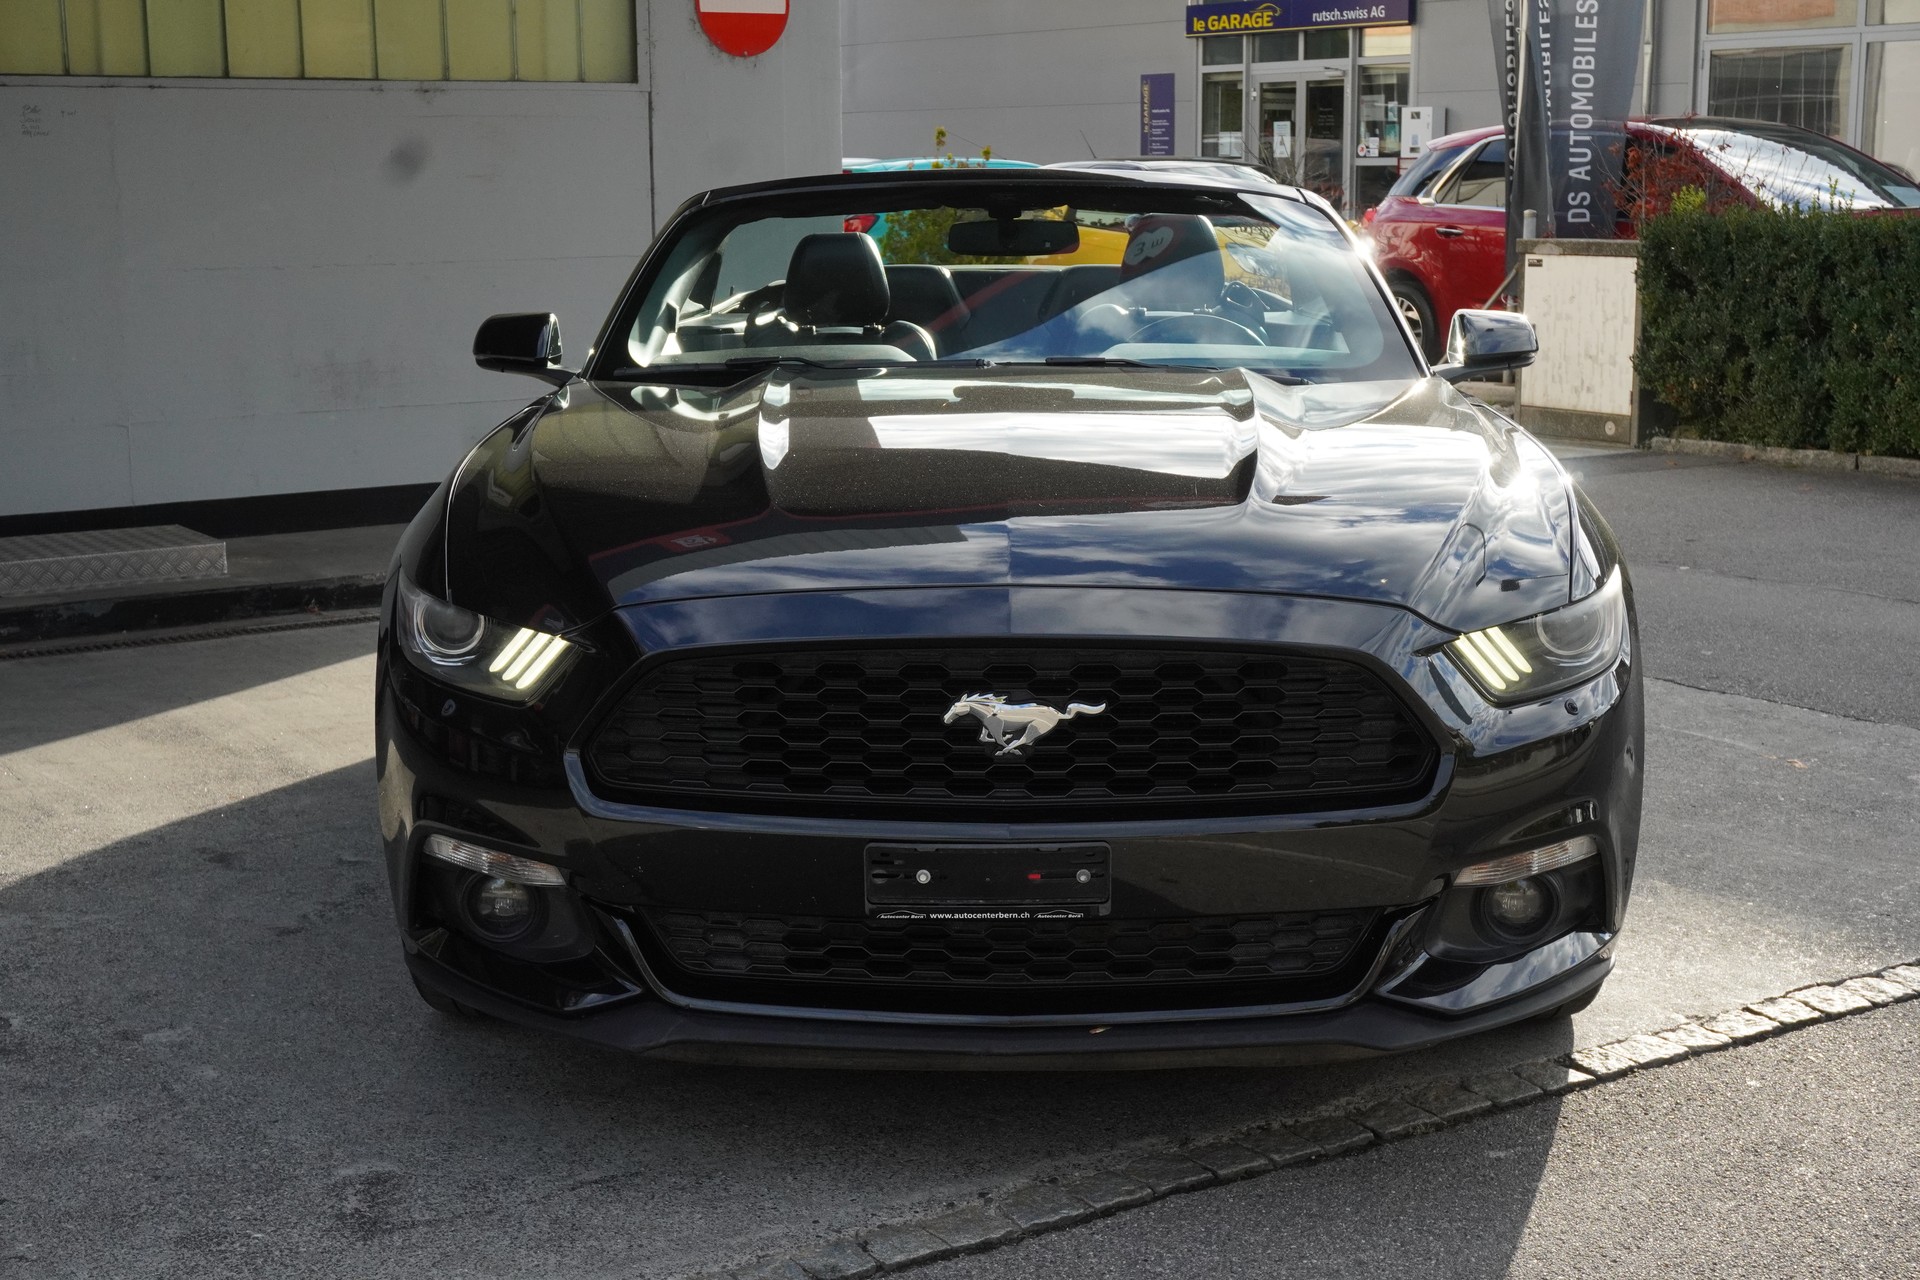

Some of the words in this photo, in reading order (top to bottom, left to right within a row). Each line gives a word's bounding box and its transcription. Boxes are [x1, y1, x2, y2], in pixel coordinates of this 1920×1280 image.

[1193, 17, 1205, 31] le
[1208, 12, 1274, 30] GARAGE
[1312, 7, 1368, 22] rutsch.swiss
[1370, 5, 1386, 18] AG
[1568, 0, 1599, 181] AUTOMOBILES
[1567, 191, 1591, 223] DS
[929, 911, 1030, 919] www.autocenterbern.ch
